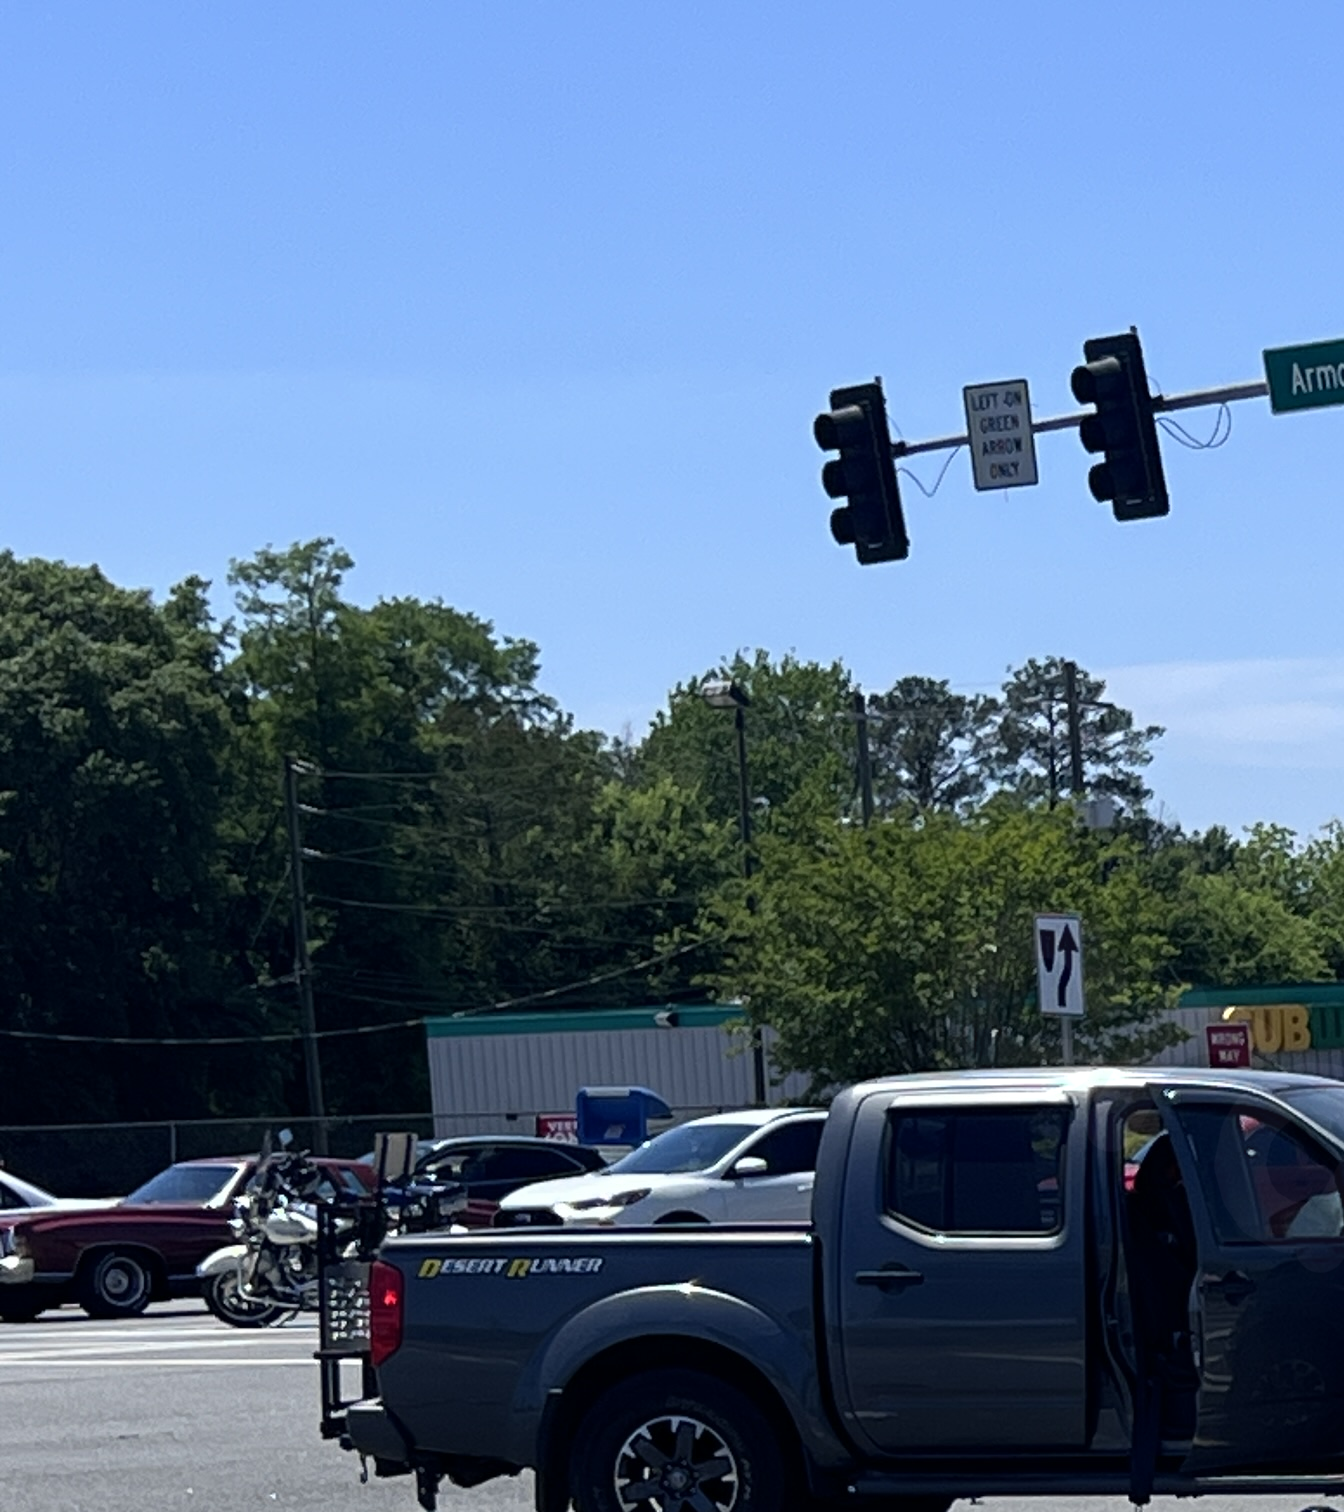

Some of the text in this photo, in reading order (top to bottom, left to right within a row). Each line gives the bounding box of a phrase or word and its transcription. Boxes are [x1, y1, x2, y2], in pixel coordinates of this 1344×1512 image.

[970, 390, 1022, 412] LEFT ON
[980, 414, 1020, 434] GREEN
[982, 436, 1022, 457] ARROW
[989, 461, 1020, 480] ONLY
[1210, 1031, 1246, 1047] WRONG
[1218, 1048, 1241, 1063] WAY
[418, 1257, 603, 1278] DESERT RUNNER
